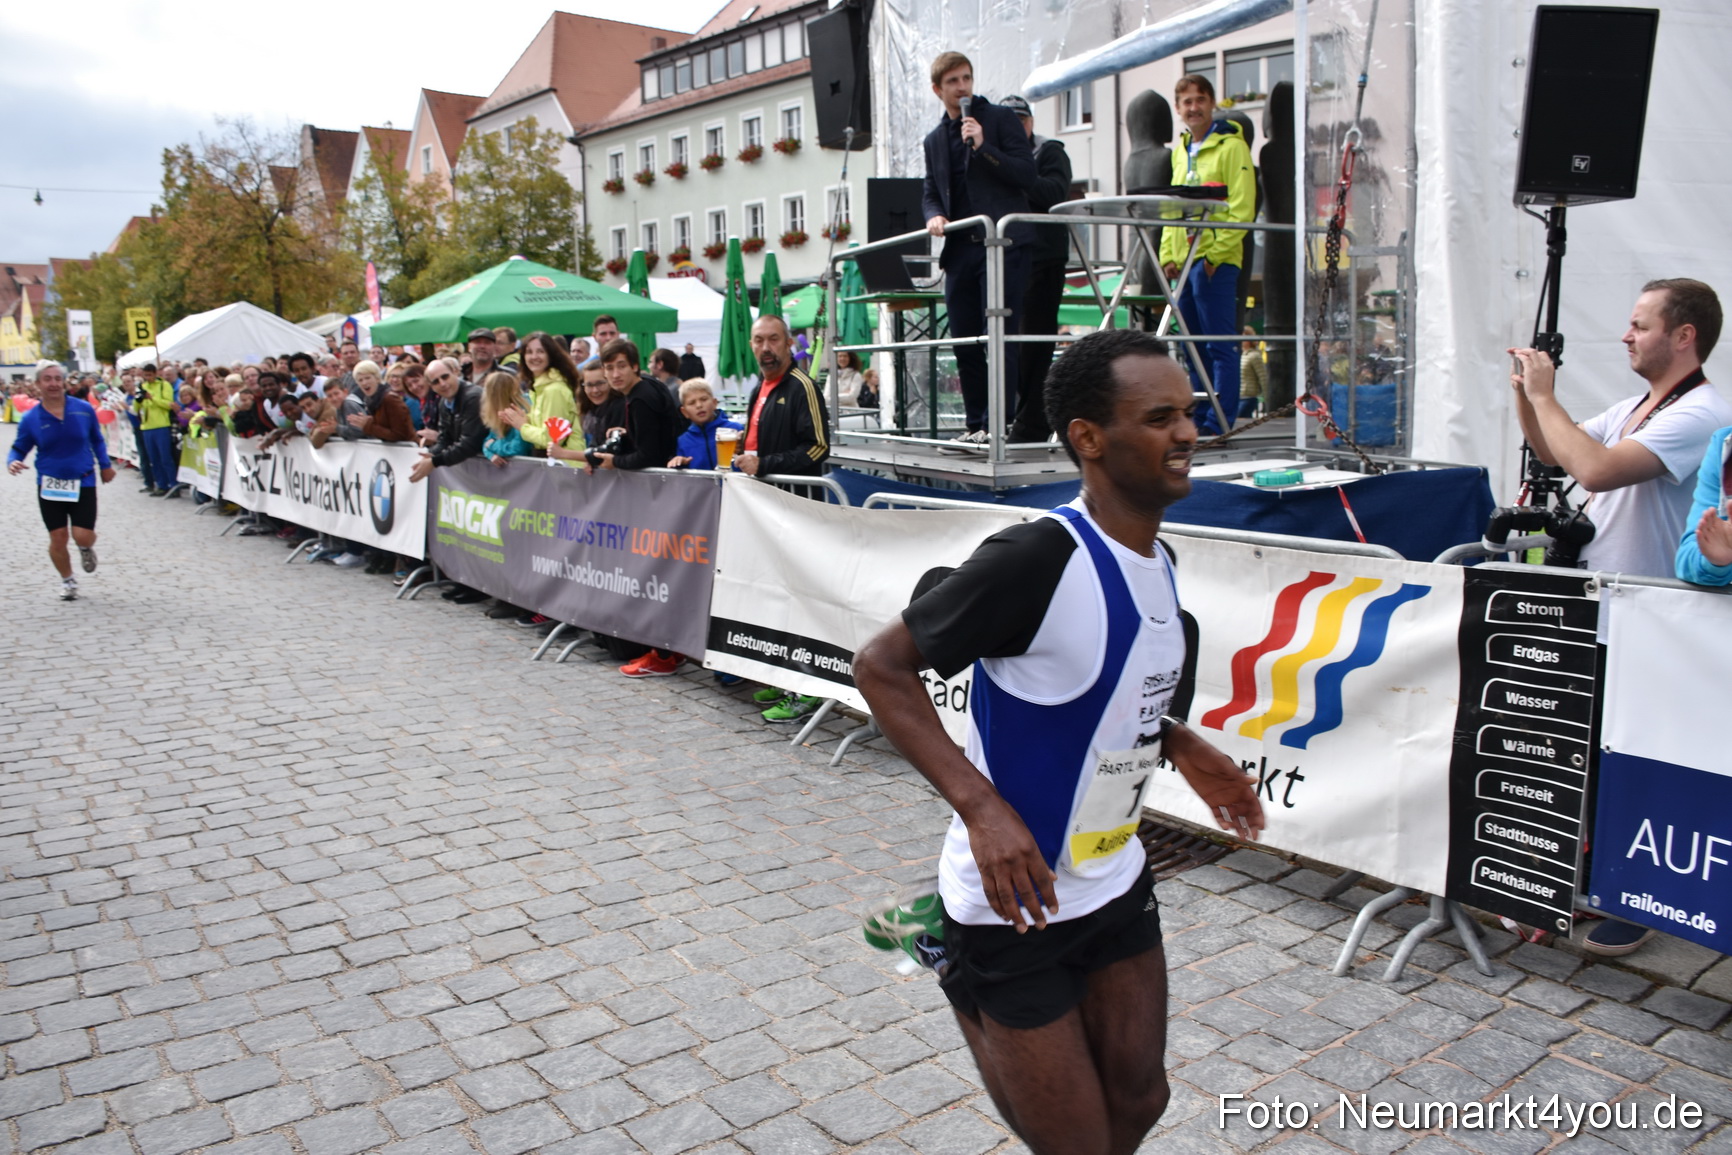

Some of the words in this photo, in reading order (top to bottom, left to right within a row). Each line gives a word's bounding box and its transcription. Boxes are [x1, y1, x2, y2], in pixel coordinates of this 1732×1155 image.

[136, 320, 150, 340] B
[46, 477, 75, 490] 2821
[283, 456, 364, 517] Neumarkt
[439, 490, 505, 540] BOCK
[509, 507, 556, 538] OFFICE
[557, 515, 629, 551] INDUSTRY
[631, 527, 711, 565] LOUNGE
[532, 554, 669, 603] www.bockonline.de
[1517, 602, 1564, 617] Strom
[727, 630, 789, 660] Leistungen,
[791, 647, 812, 665] die
[814, 653, 854, 677] verbin
[1513, 644, 1560, 664] Erdgas
[1505, 690, 1559, 710] Wasser
[1502, 738, 1556, 758] Wärme
[1126, 774, 1149, 818] 1
[1500, 781, 1554, 804] Freizeit
[1484, 821, 1560, 853] Stadtbusse
[1626, 818, 1732, 881] AUF
[1480, 866, 1557, 899] Parkhäuser
[1620, 891, 1717, 934] railone.de
